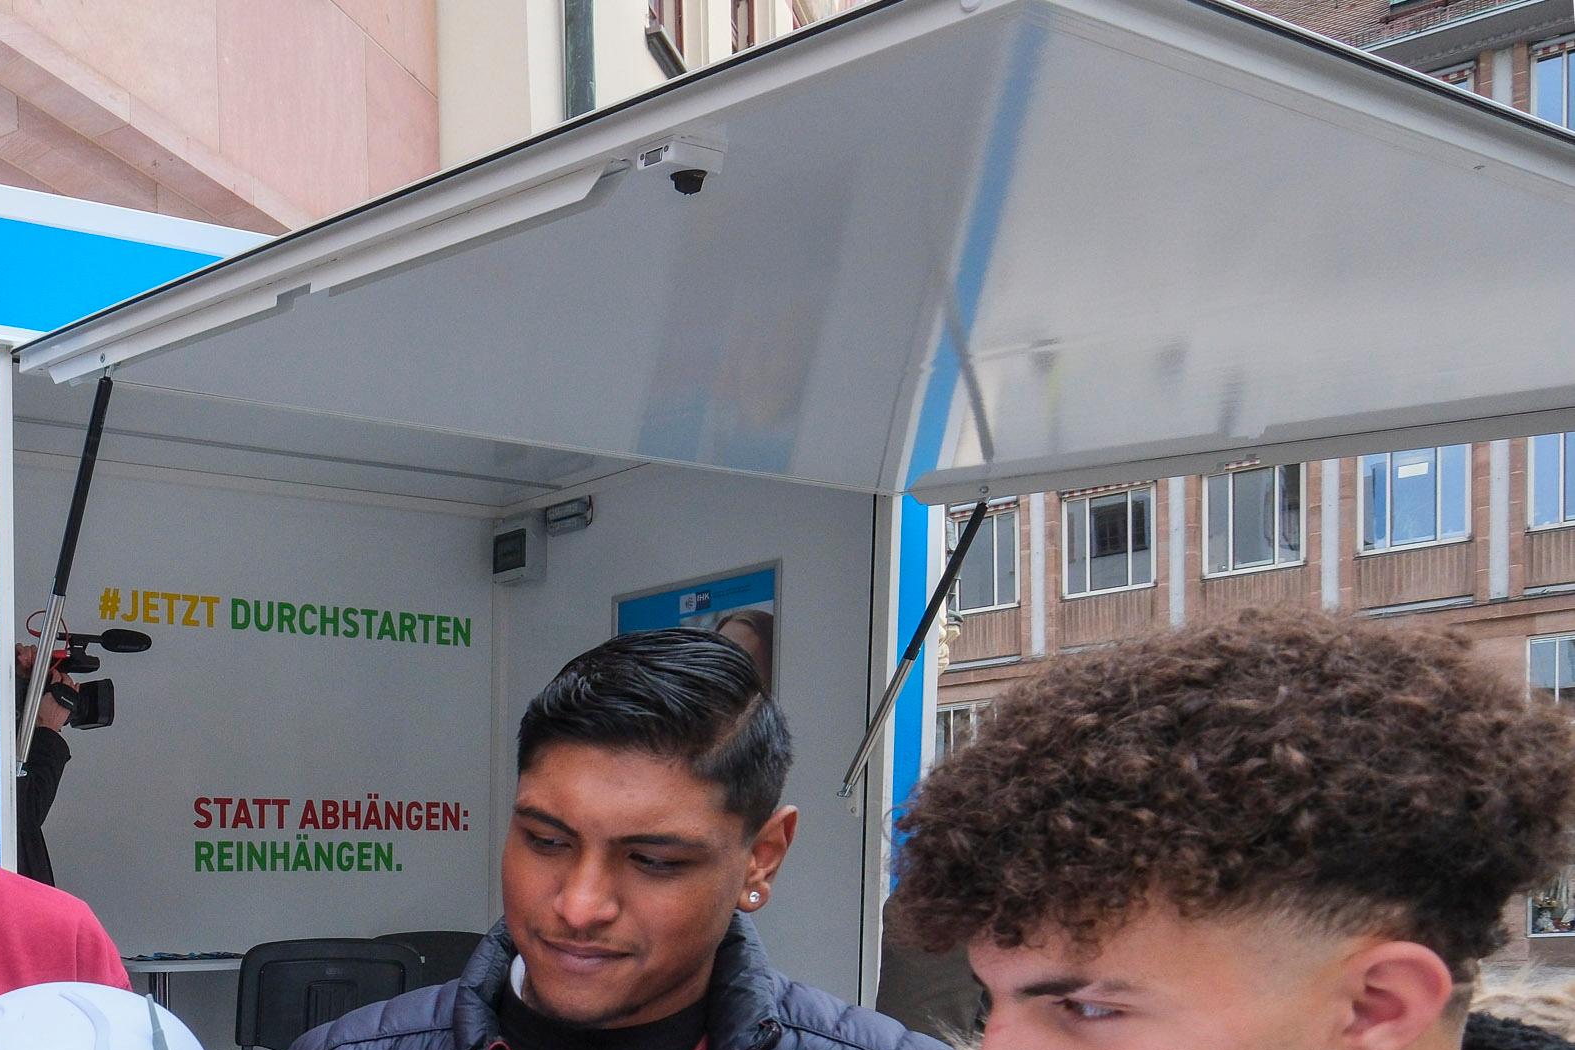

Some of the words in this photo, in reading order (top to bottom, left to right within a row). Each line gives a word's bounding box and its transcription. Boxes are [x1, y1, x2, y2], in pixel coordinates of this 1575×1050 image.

[99, 587, 220, 628] #JETZT
[230, 597, 472, 647] DURCHSTARTEN
[193, 796, 290, 830] STATT
[299, 793, 469, 832] ABHÄNGEN:
[194, 834, 403, 873] REINHÄNGEN.
